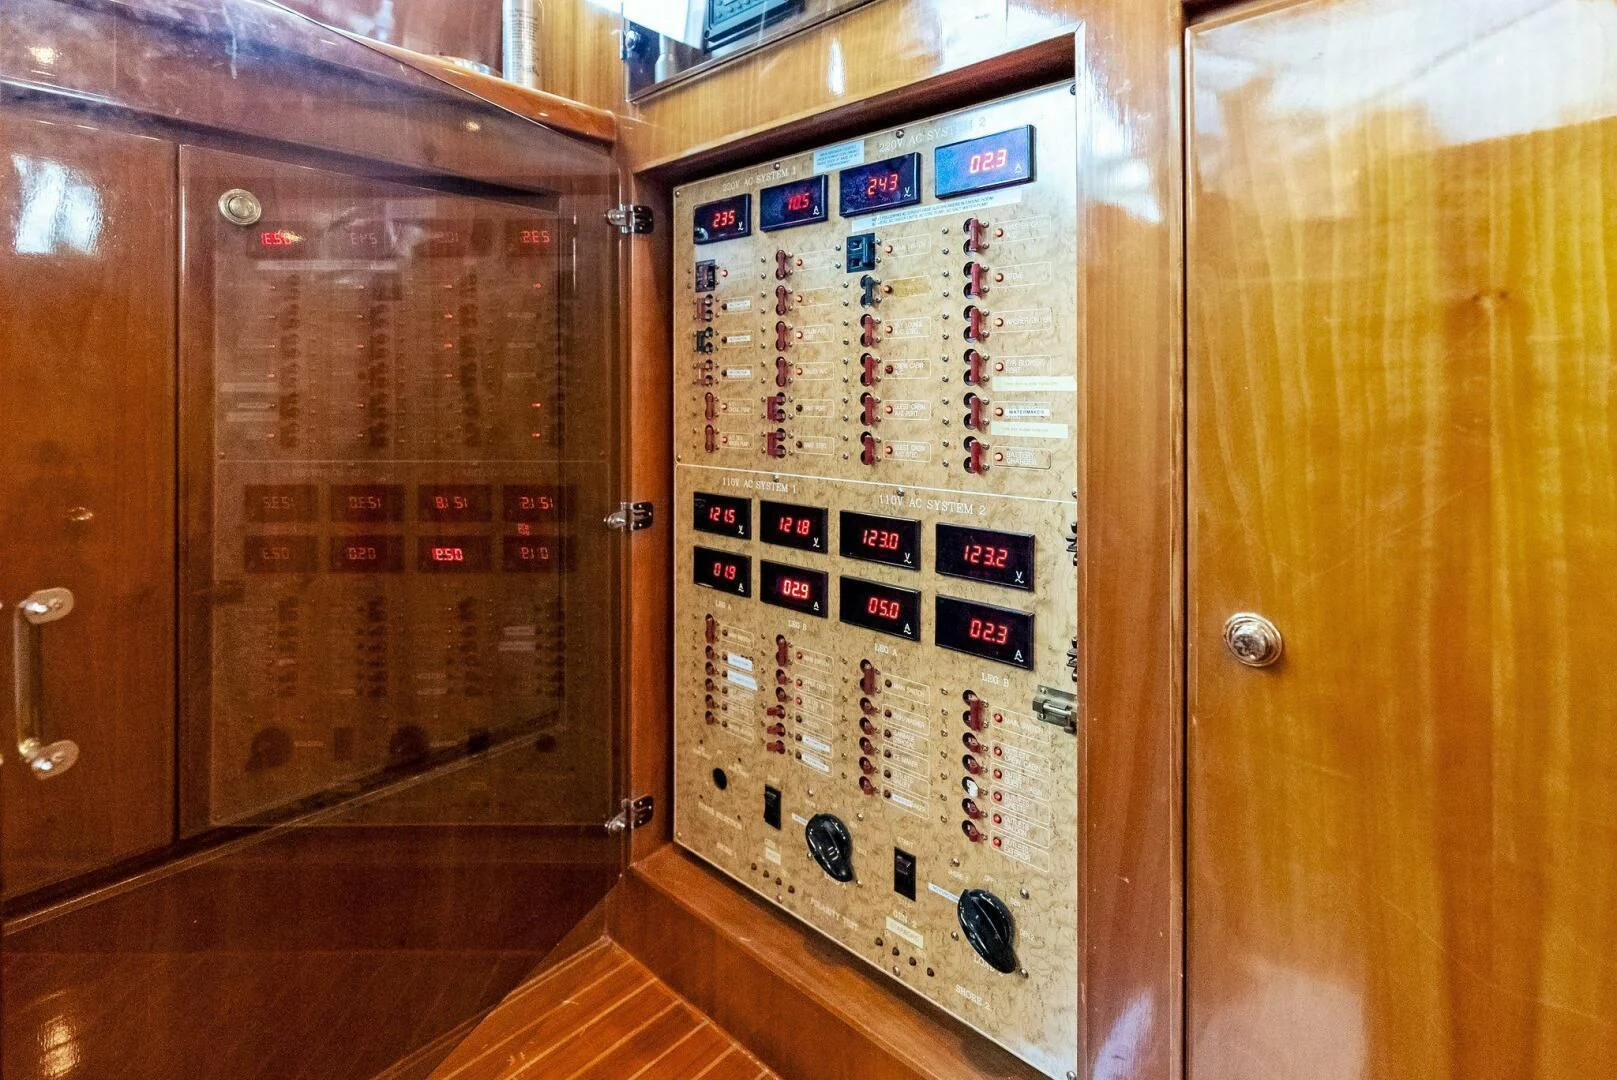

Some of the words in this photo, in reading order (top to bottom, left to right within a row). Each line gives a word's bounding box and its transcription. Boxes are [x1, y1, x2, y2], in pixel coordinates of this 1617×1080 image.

[879, 138, 904, 152] 220V
[909, 133, 923, 145] AC
[969, 148, 1008, 174] 02.3
[756, 169, 788, 182] SYSTEM
[867, 173, 898, 196] 243
[712, 209, 736, 228] 235
[722, 477, 741, 488] 110V
[744, 480, 753, 489] AC
[755, 481, 788, 493] SYSTEM
[709, 506, 735, 523] 121.5
[879, 494, 904, 506] 110V
[909, 499, 923, 509] AC
[927, 501, 974, 515] SYSTEM
[979, 506, 987, 516] 2
[779, 516, 810, 535] 121.8
[863, 529, 899, 550] 123.0
[963, 545, 1008, 567] 123.2
[782, 579, 809, 599] 02.9
[868, 596, 899, 620] 05.0
[969, 618, 1008, 645] 02.3
